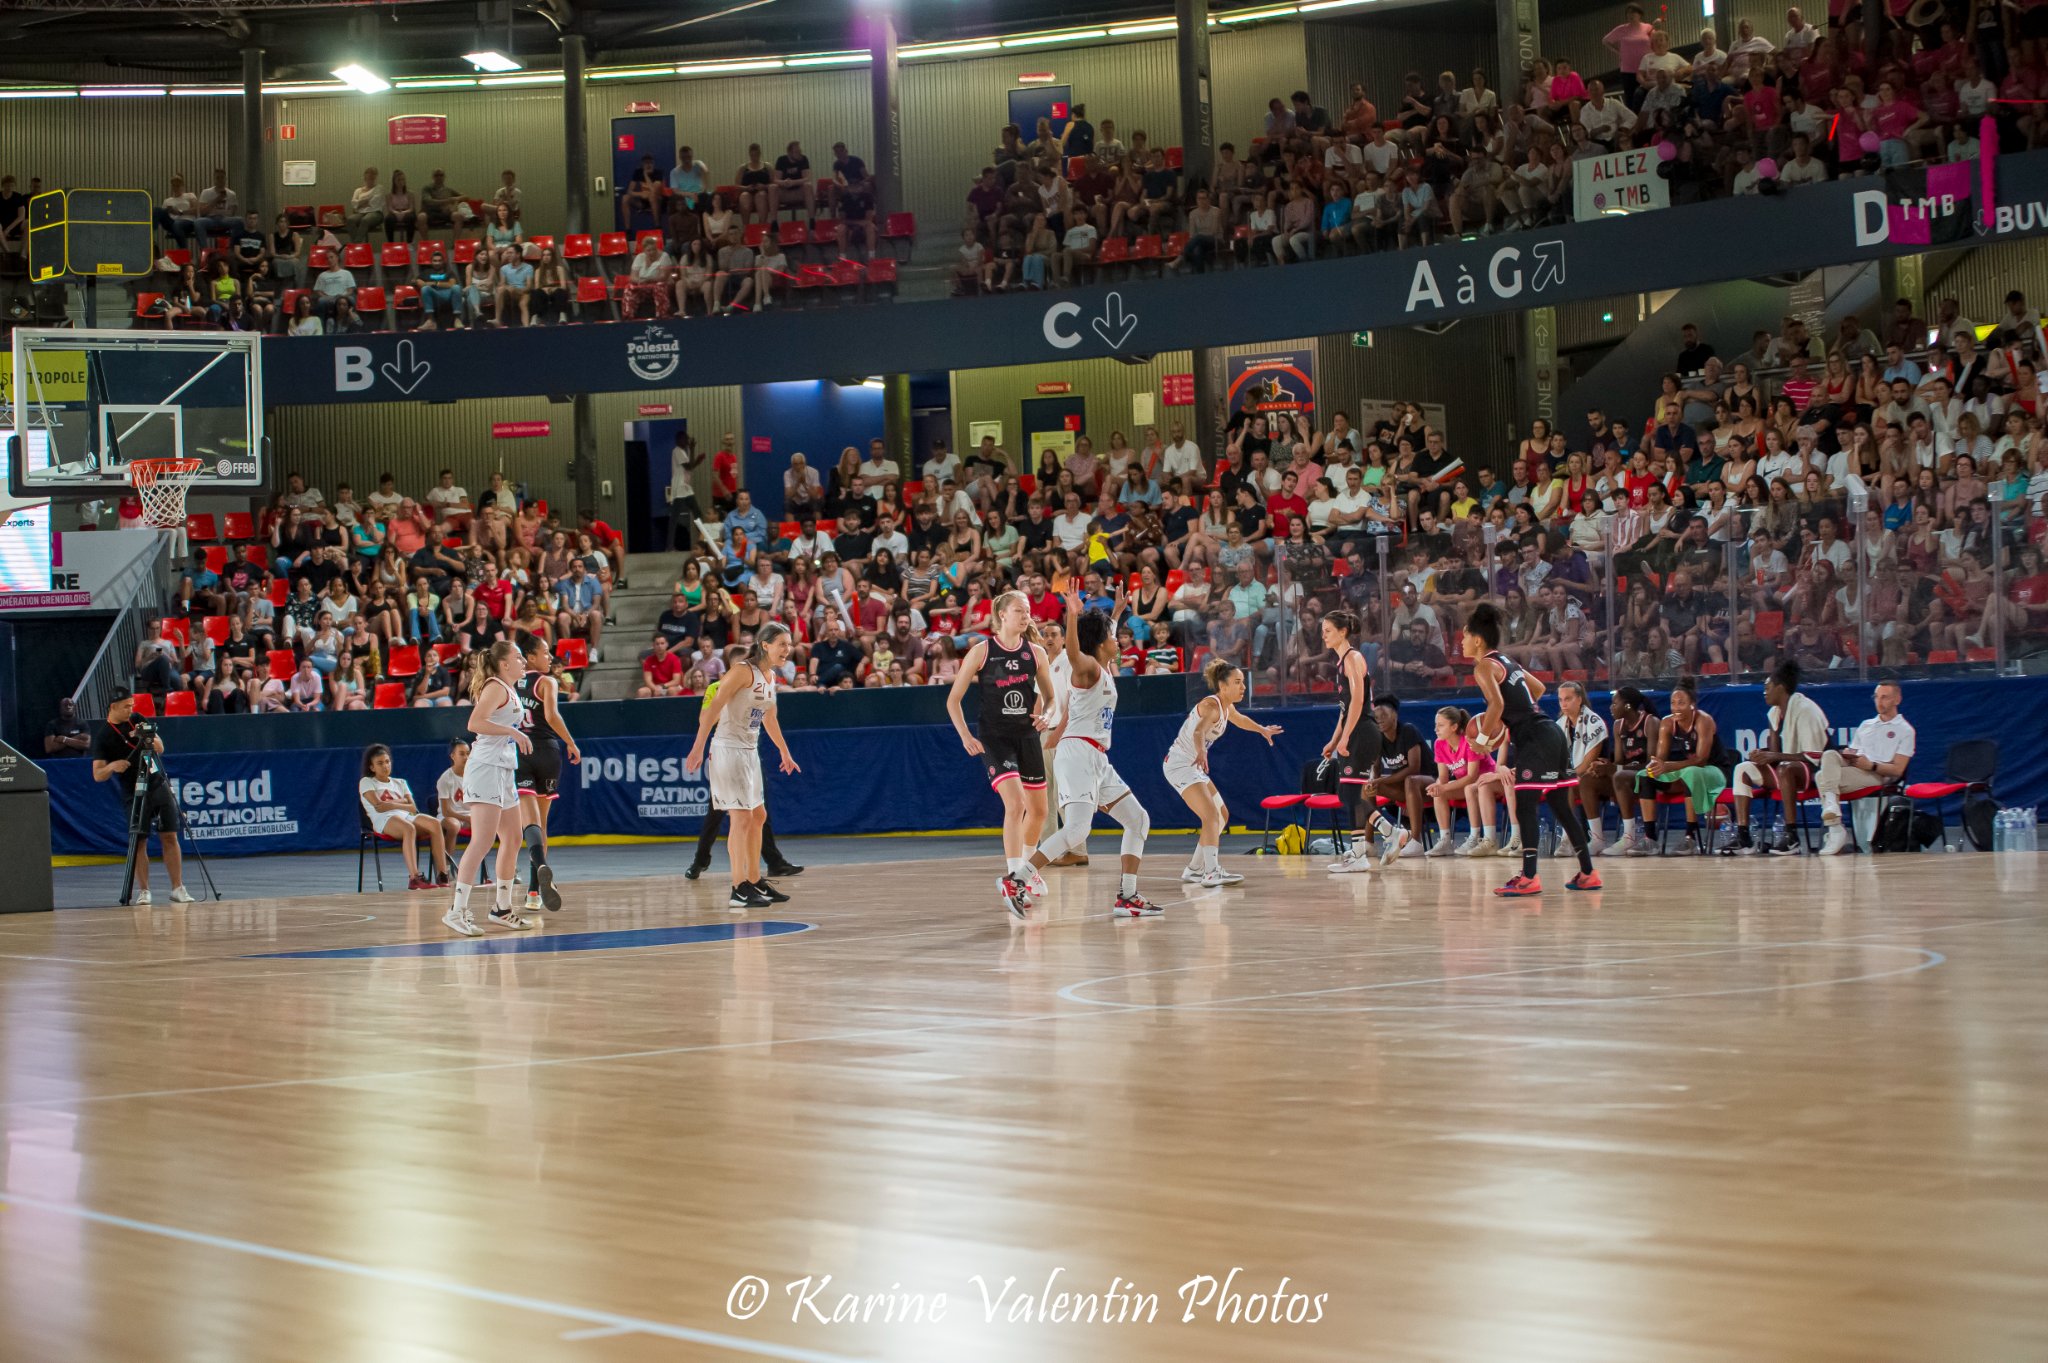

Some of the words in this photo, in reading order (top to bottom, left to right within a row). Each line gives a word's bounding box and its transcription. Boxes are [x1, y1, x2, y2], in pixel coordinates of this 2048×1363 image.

[1519, 33, 1534, 71] CON
[1199, 103, 1210, 147] BALC
[1593, 152, 1648, 182] ALLEZ
[1614, 184, 1651, 207] TMB
[1899, 194, 1955, 221] TMB
[1853, 190, 1890, 247] D
[1405, 259, 1445, 312] A
[1456, 264, 1475, 304] à
[1488, 247, 1522, 298] G
[1043, 302, 1082, 349] C
[627, 340, 680, 353] Polesud
[334, 346, 375, 392] B
[232, 462, 256, 474] FFBB
[1005, 659, 1019, 670] 45
[753, 682, 766, 694] 21
[186, 805, 287, 824] PATINOIRE
[248, 823, 295, 834] GRENOBLOISE
